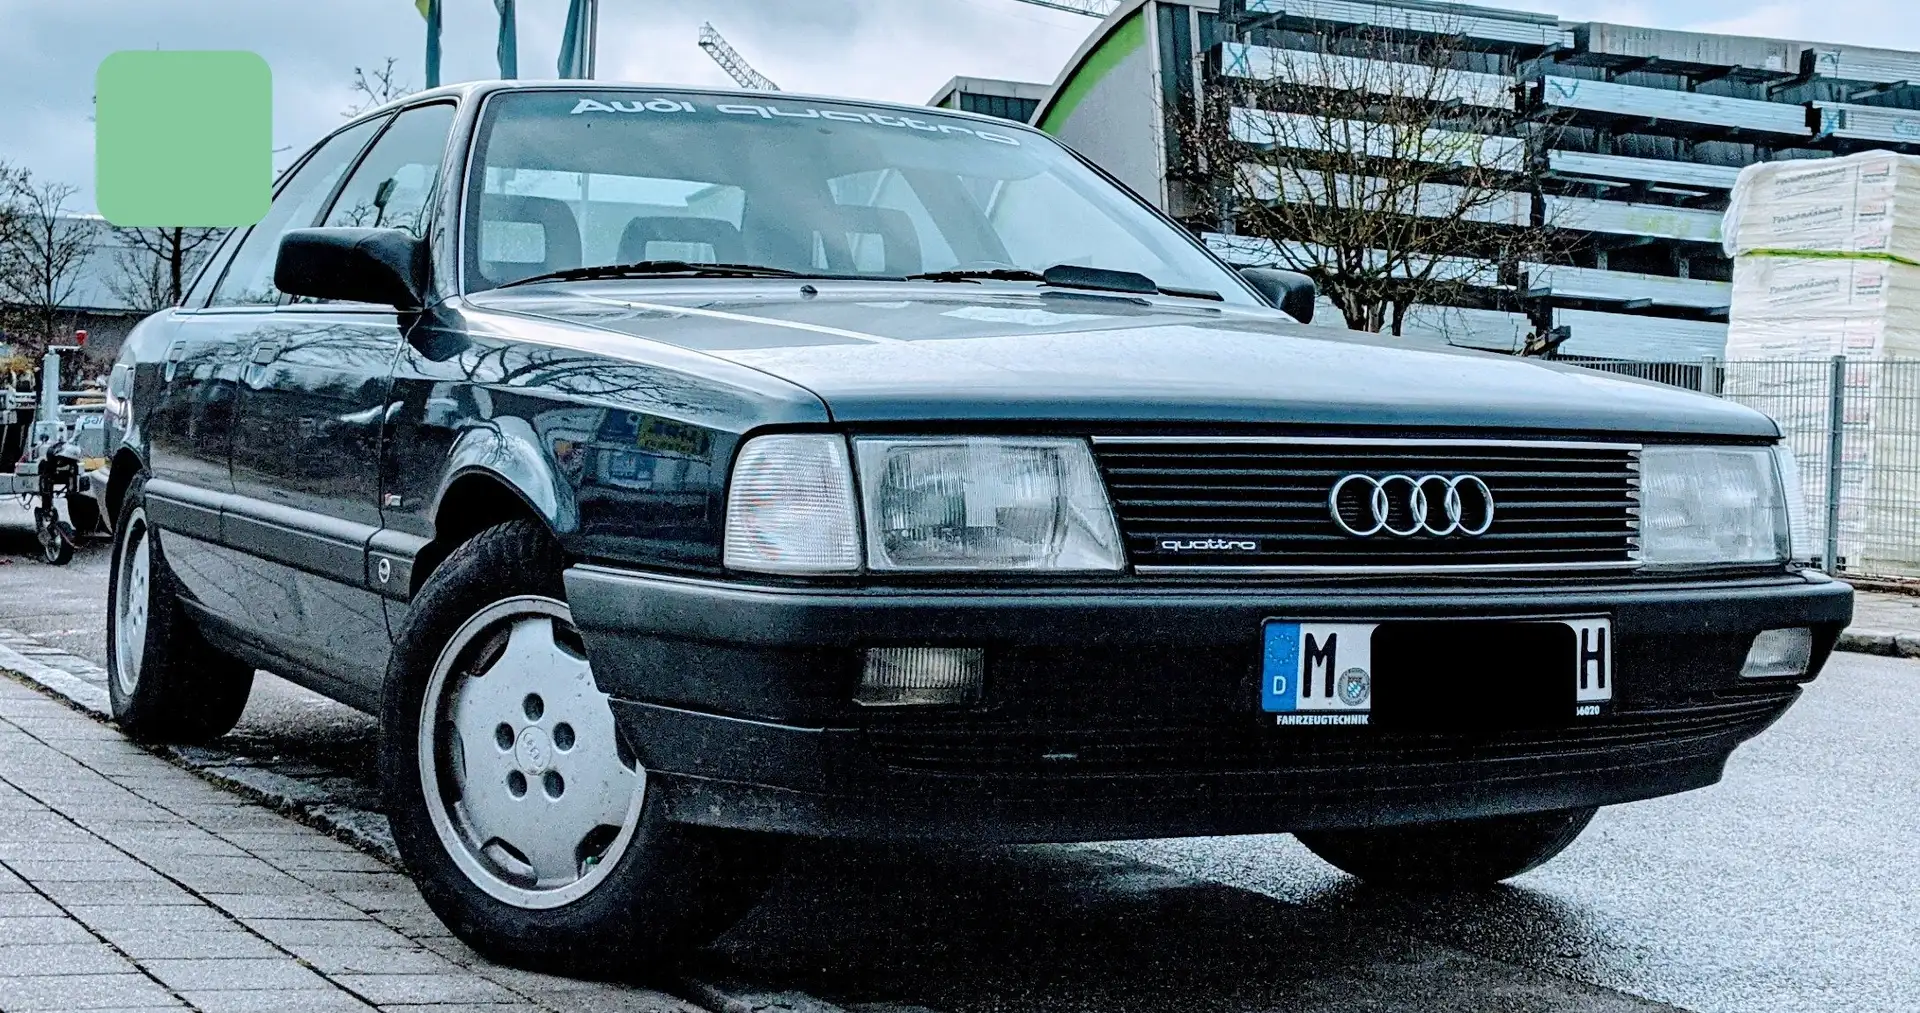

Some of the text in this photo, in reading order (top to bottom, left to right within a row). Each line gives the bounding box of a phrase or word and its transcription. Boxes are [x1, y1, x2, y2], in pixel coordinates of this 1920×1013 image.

[570, 97, 1021, 147] Audi quattro
[1161, 538, 1256, 552] quattro
[1302, 632, 1338, 699] M
[1580, 627, 1606, 689] H
[1272, 675, 1287, 695] D
[1276, 714, 1370, 726] FAHRZEUGTECHNIK
